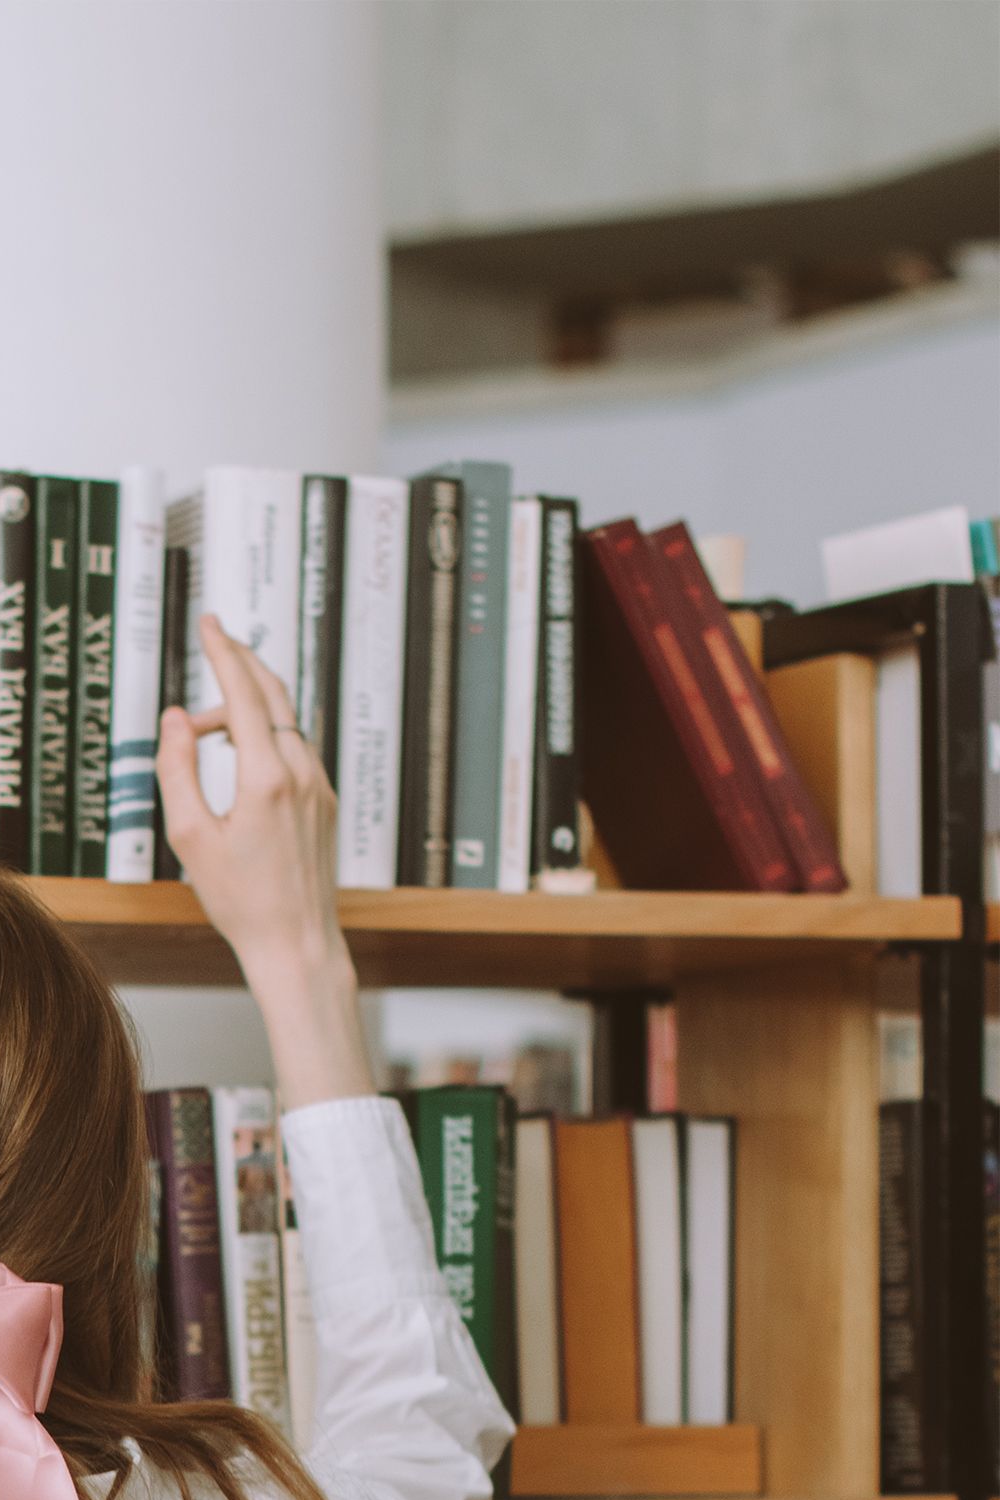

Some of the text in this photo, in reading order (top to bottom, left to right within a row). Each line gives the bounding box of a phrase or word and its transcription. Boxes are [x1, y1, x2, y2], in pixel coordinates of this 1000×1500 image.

[41, 604, 70, 836] РИЧАРД БАХ
[79, 613, 111, 843] РИЧАРД БАХ
